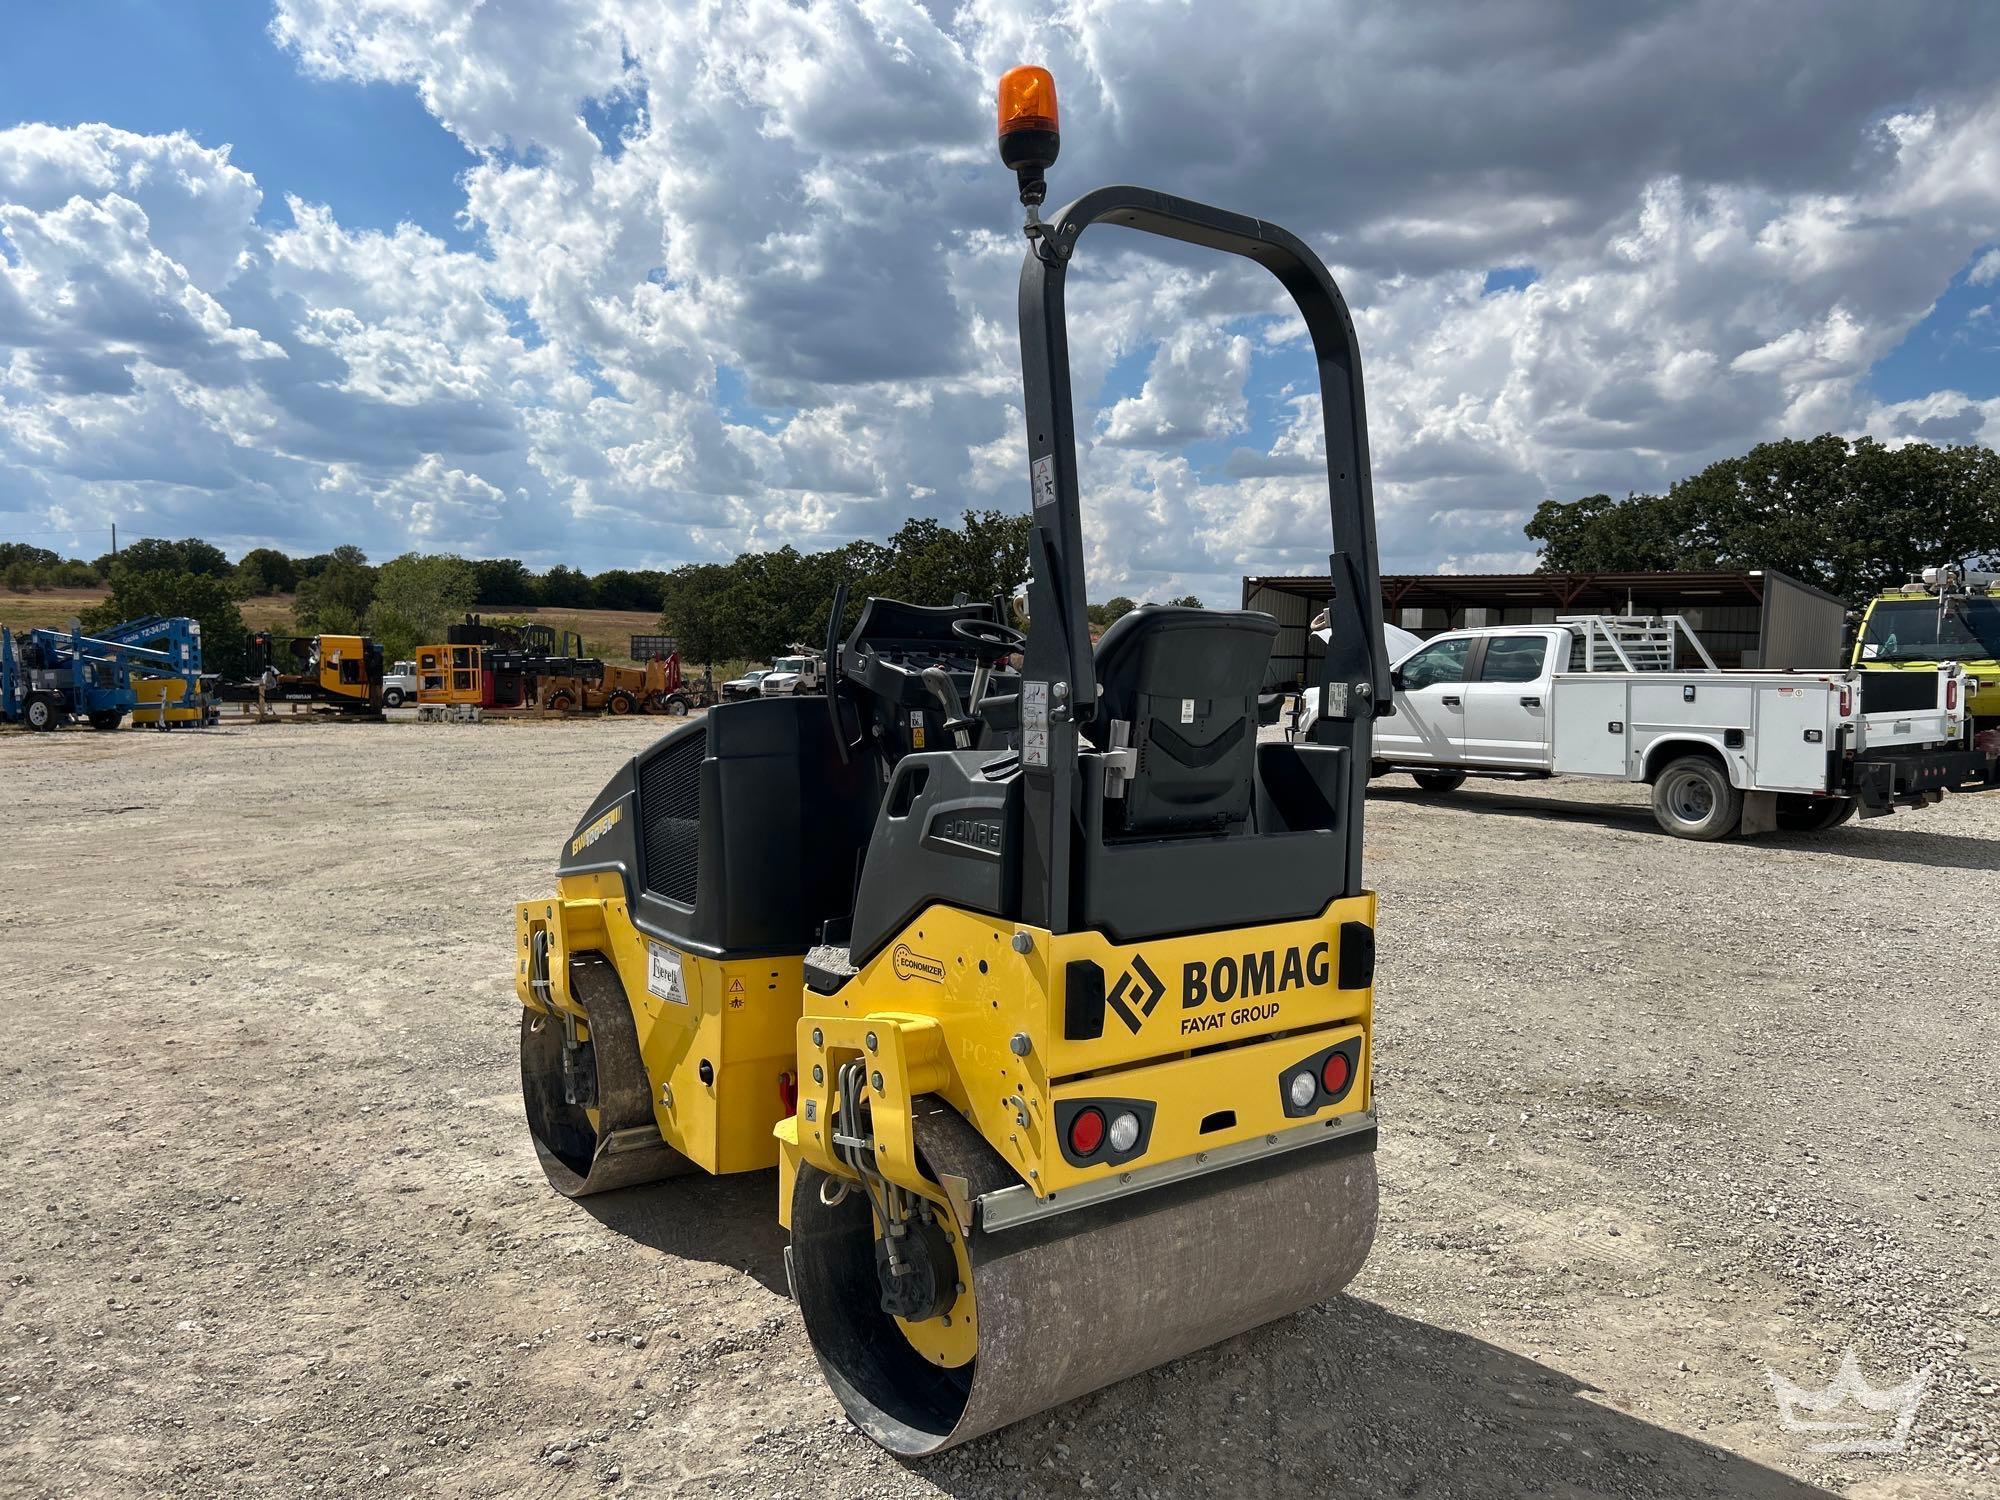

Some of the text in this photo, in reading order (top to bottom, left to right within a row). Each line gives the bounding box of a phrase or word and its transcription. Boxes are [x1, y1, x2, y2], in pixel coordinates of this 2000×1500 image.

[900, 957, 943, 977] ECONOMIZER
[1182, 942, 1330, 1009] BOMAG
[1181, 1002, 1280, 1035] FAYAT GROUP
